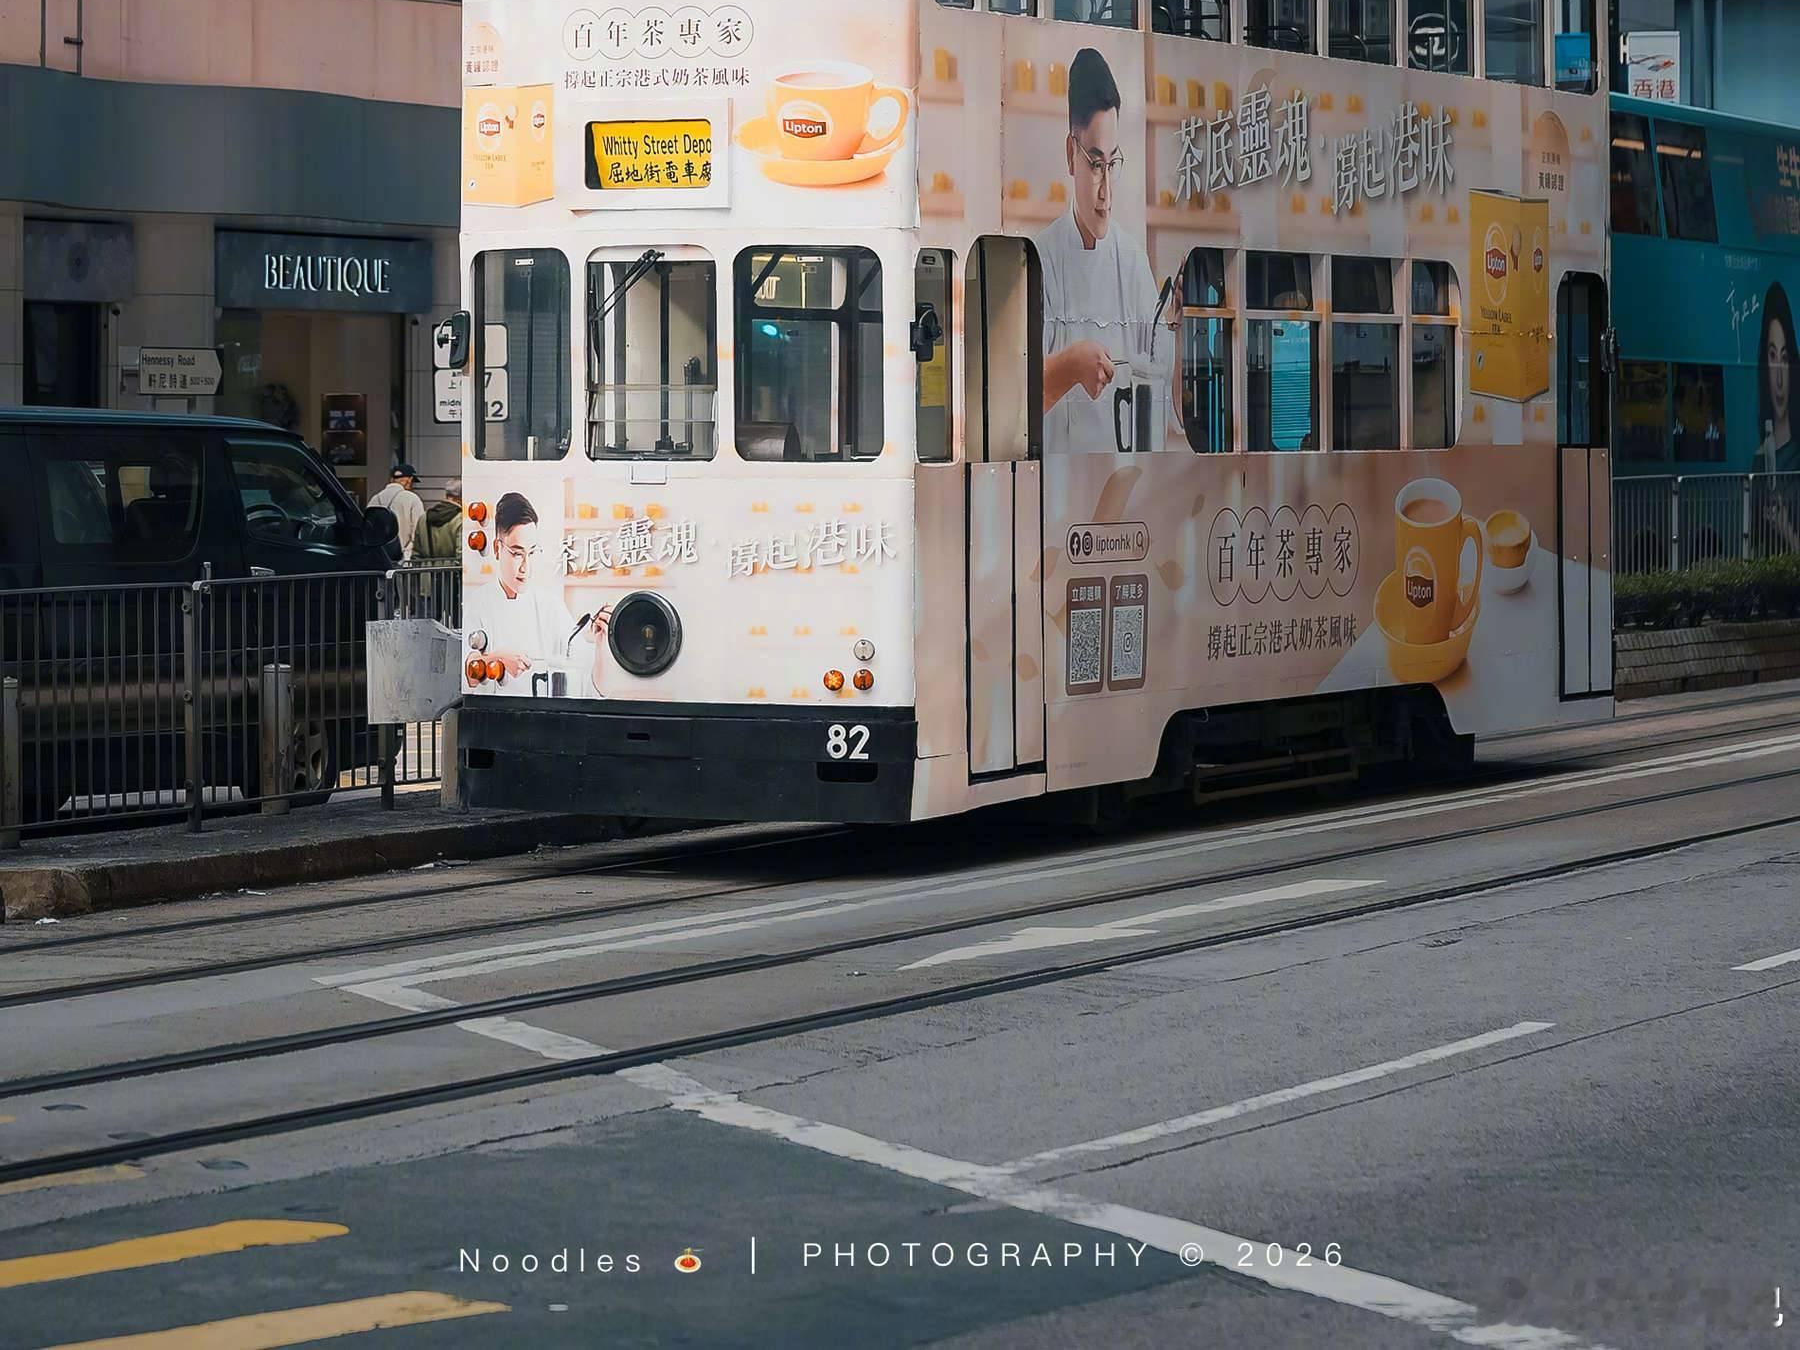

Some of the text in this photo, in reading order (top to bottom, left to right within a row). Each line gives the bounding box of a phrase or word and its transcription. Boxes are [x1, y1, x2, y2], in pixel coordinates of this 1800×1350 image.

[573, 17, 743, 49] 百年茶專家
[1633, 78, 1676, 99] 香港
[784, 120, 824, 135] Lipton
[602, 134, 711, 160] Whitty Street Depo
[265, 254, 390, 297] BEAUTIQUE
[142, 353, 196, 368] Hennessy Road
[1095, 532, 1131, 555] liptonhk
[1215, 526, 1353, 583] 百年茶專家
[1407, 580, 1432, 601] Lipton
[1207, 613, 1358, 661] 撐起正宗港式奶茶風味
[825, 724, 870, 760] 82
